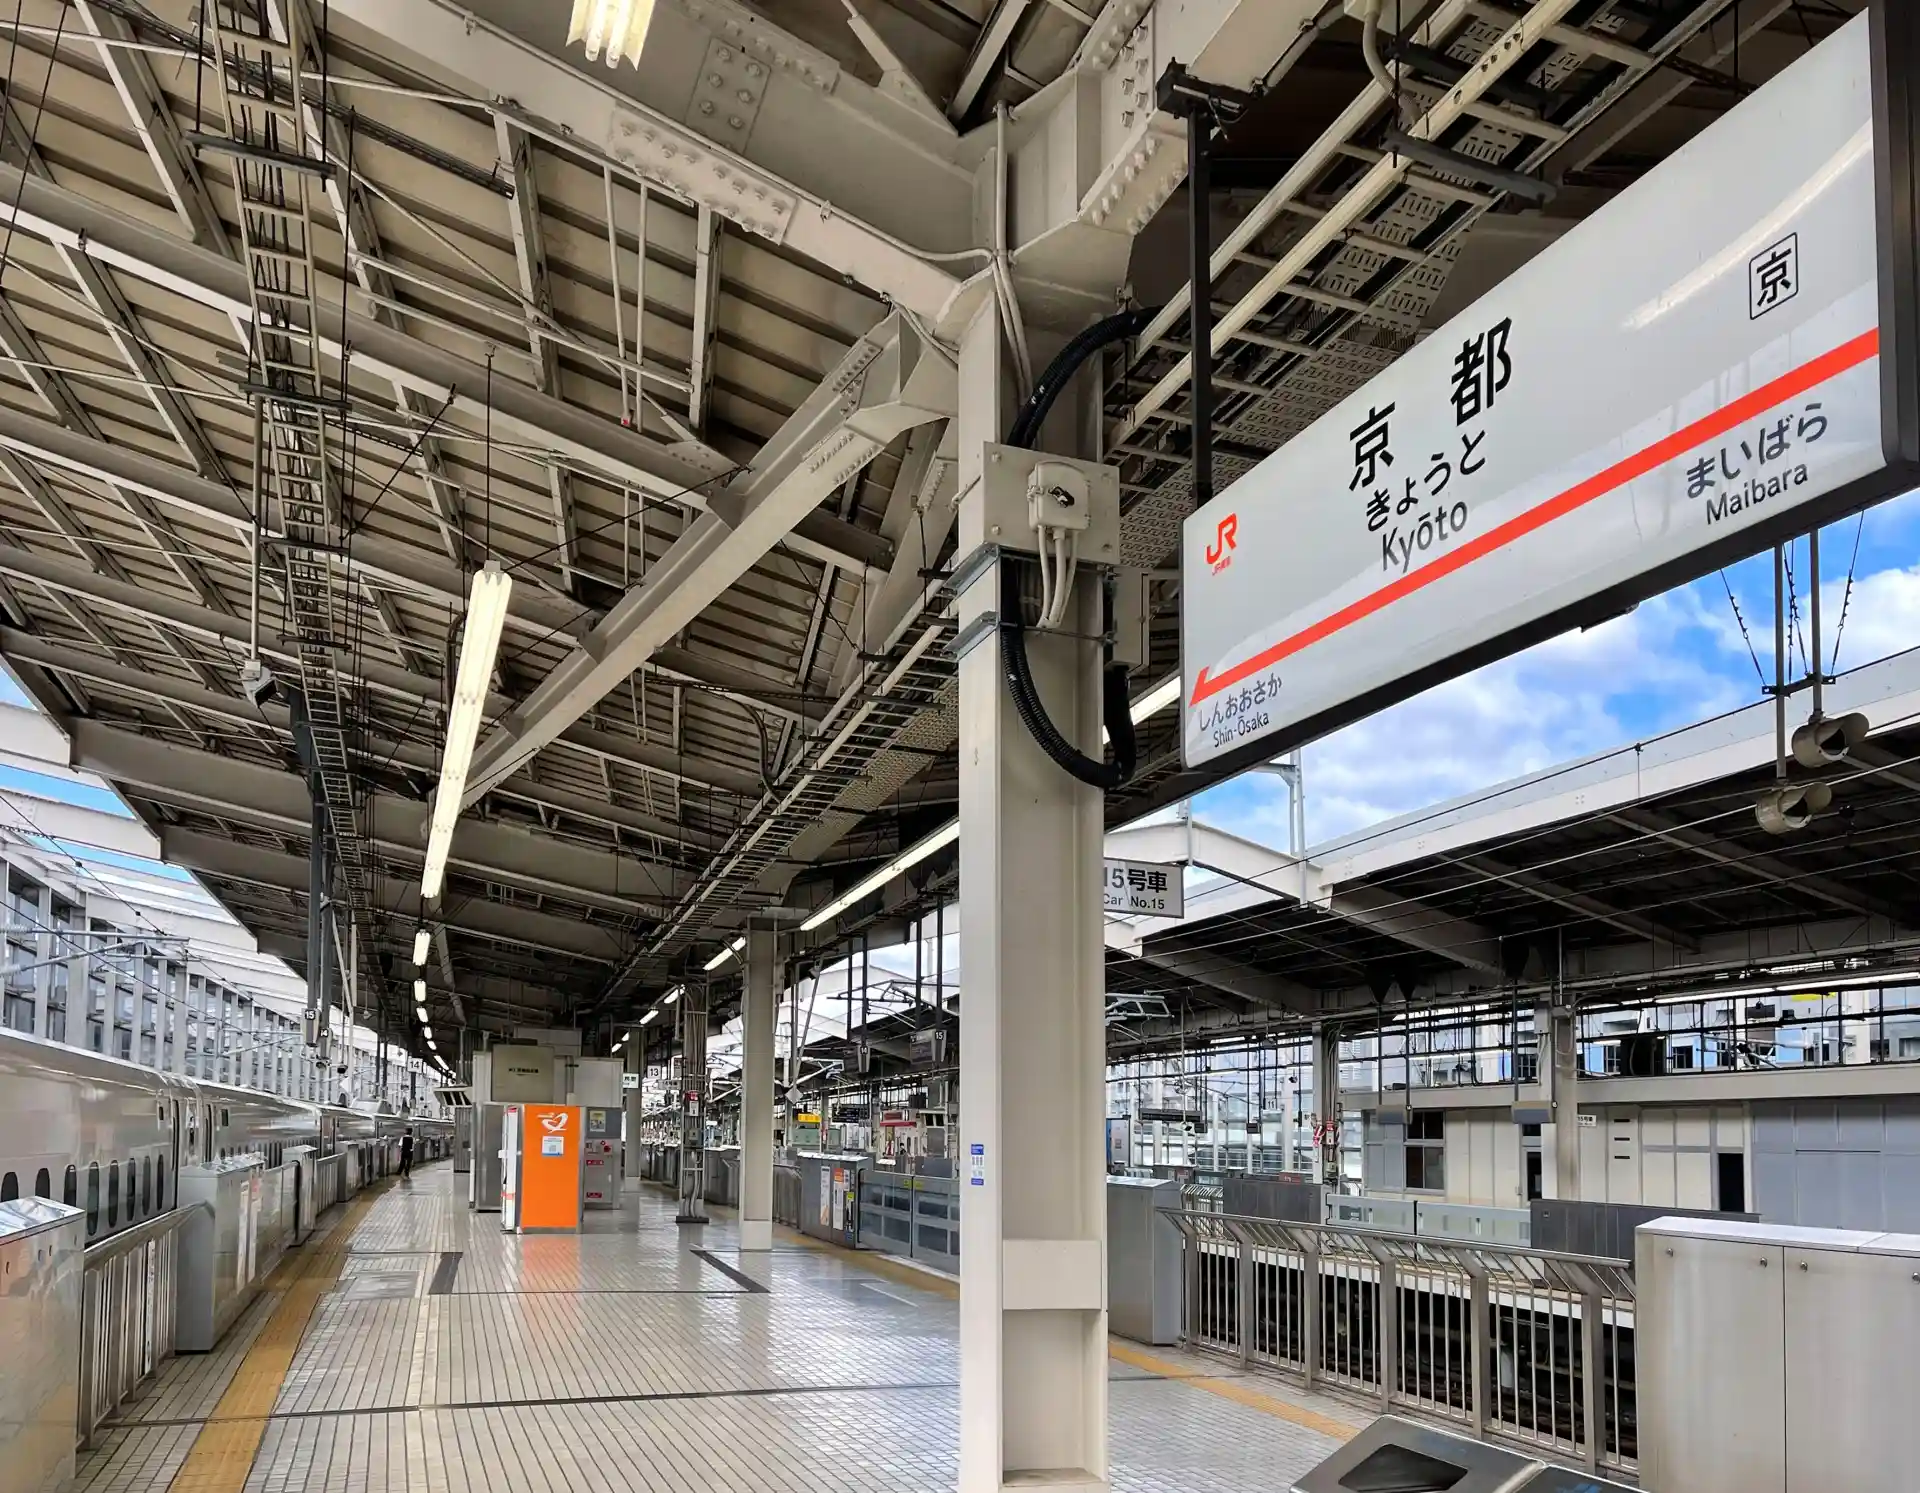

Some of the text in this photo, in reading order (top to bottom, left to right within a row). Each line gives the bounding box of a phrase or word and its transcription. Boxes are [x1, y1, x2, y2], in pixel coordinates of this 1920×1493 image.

[1756, 248, 1792, 307] 京
[1349, 316, 1512, 491] 京都
[1686, 403, 1828, 499] まいばら
[1366, 430, 1486, 532] きょうと
[1706, 463, 1809, 525] Maibara
[1206, 512, 1237, 565] JR
[1382, 501, 1468, 574] Kyōto
[1199, 672, 1282, 732] しんおおさか
[1213, 711, 1270, 748] Shin-Ōsaka
[1103, 893, 1165, 910] Car No.15
[1104, 867, 1168, 893] 15号車
[305, 1011, 315, 1020] 15
[935, 1031, 943, 1040] 15
[410, 1060, 419, 1069] 14
[650, 1068, 659, 1077] 13
